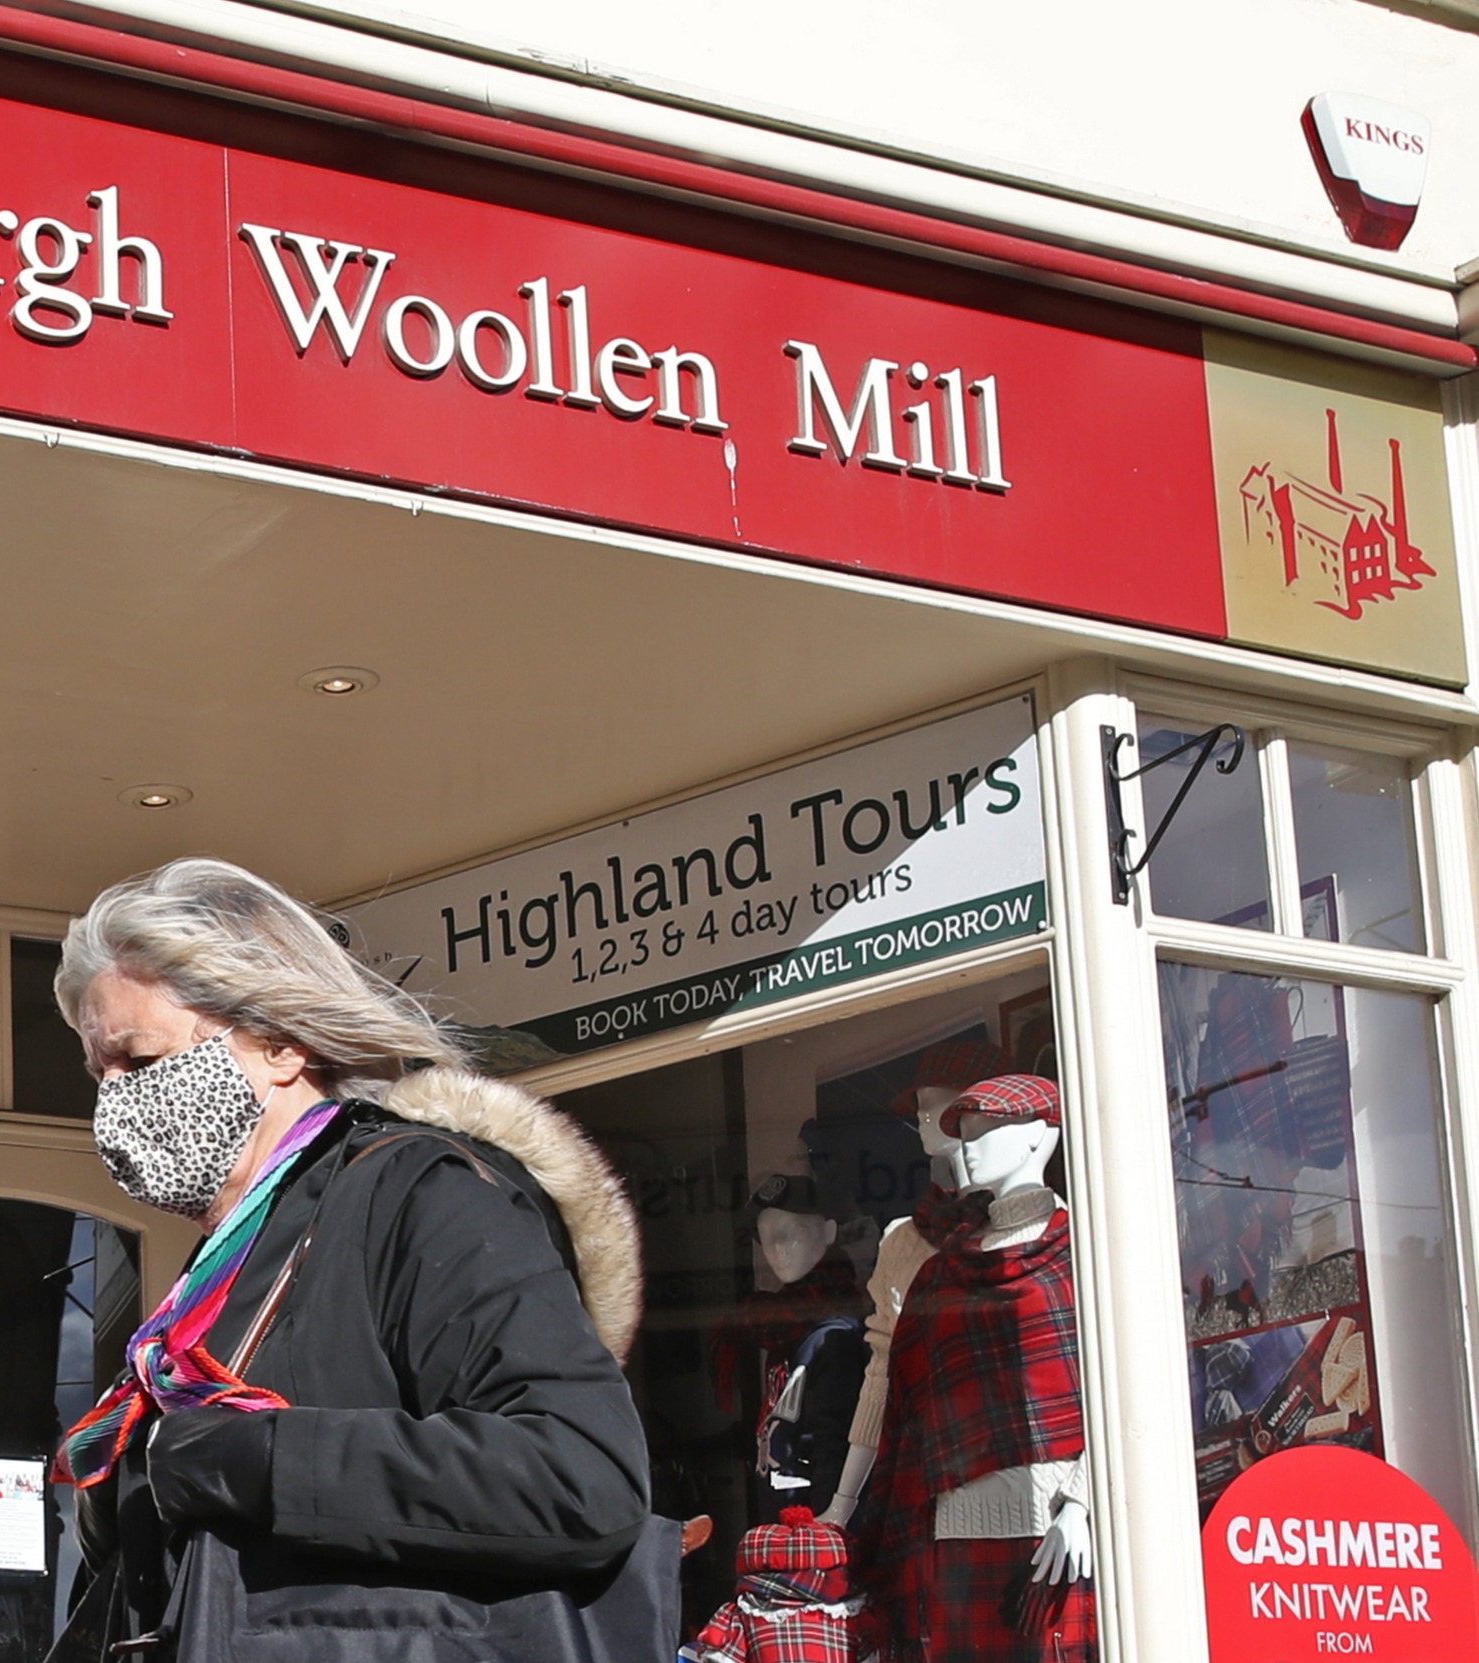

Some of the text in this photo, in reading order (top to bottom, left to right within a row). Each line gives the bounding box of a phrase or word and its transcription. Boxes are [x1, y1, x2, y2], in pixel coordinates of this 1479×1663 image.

[1344, 117, 1424, 155] KINGS
[238, 222, 729, 434] Woollen
[783, 339, 1012, 493] Mill
[441, 756, 1022, 973] Highland Tours
[661, 919, 686, 957] &
[694, 910, 720, 945] 4
[730, 889, 798, 940] day
[809, 864, 913, 916] tours
[574, 892, 1034, 1042] BOOK TODAY, TRAVEL TOMORROW
[1226, 1515, 1443, 1570] CASHMERE
[1250, 1580, 1432, 1622] KNITWEAR
[1316, 1631, 1374, 1654] FROM
